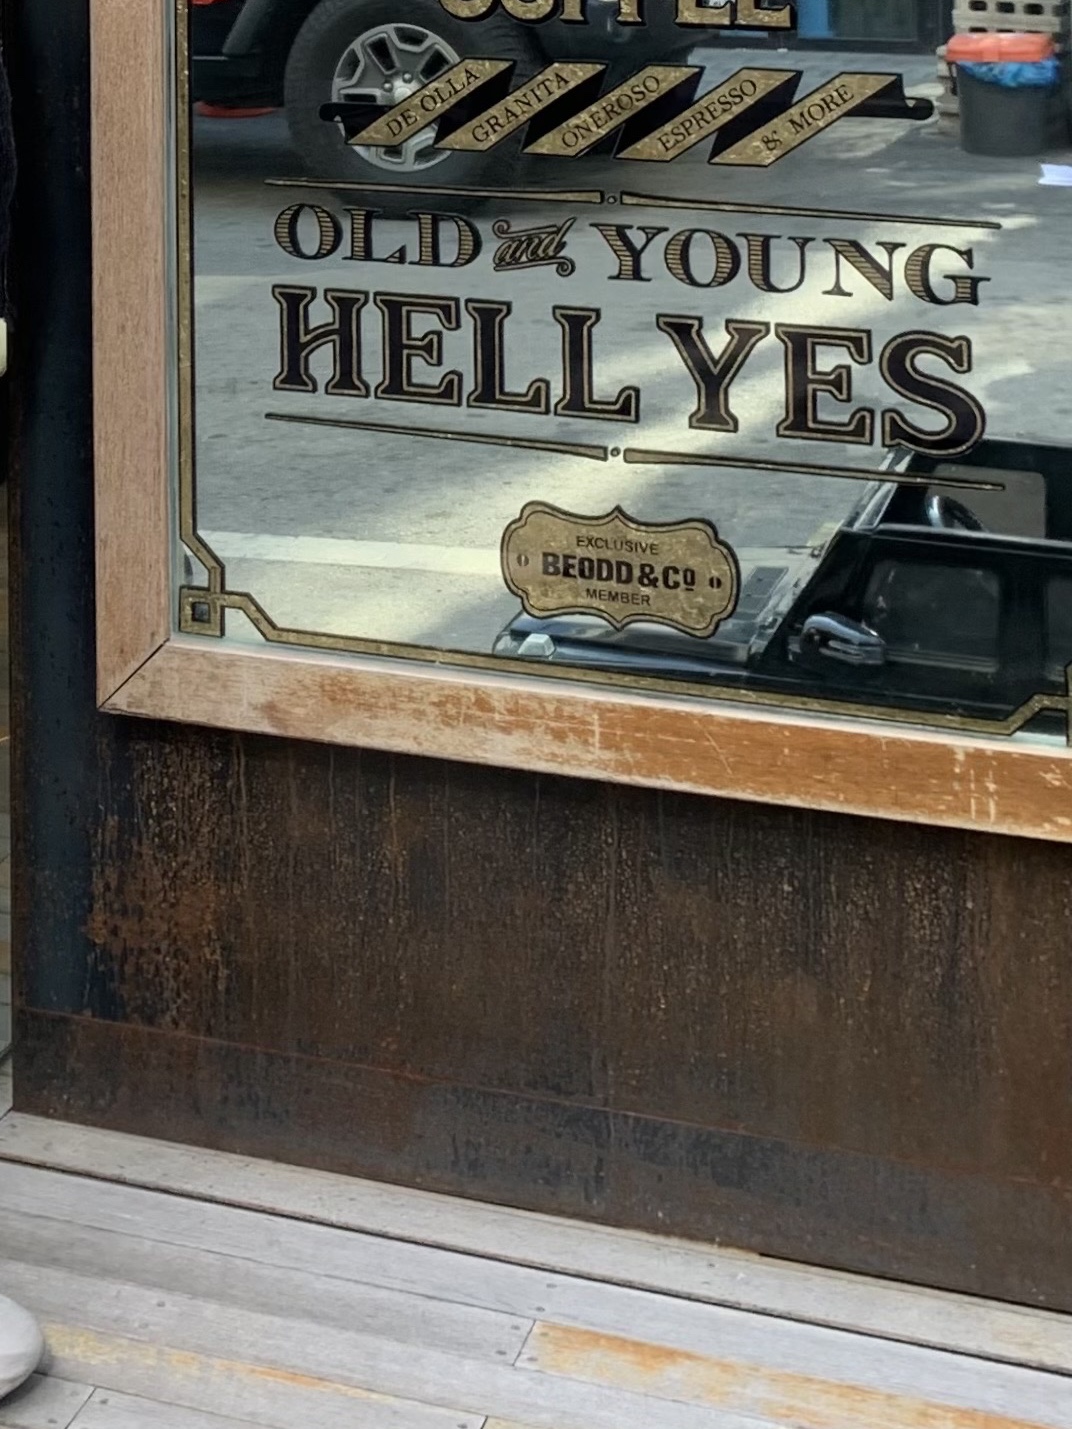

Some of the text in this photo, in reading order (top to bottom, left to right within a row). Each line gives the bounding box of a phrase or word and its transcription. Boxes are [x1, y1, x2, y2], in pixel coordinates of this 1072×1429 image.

[385, 68, 481, 138] DE OLLA
[471, 72, 571, 144] GRANITA
[561, 74, 661, 150] ONEROSO
[656, 78, 757, 153] ESPRESSO
[761, 84, 855, 152] & MORE
[274, 202, 991, 306] OLD and YOUNG
[270, 284, 986, 456] HELL YES
[576, 535, 660, 556] EXCLUSIVE
[585, 587, 651, 607] MEMBER
